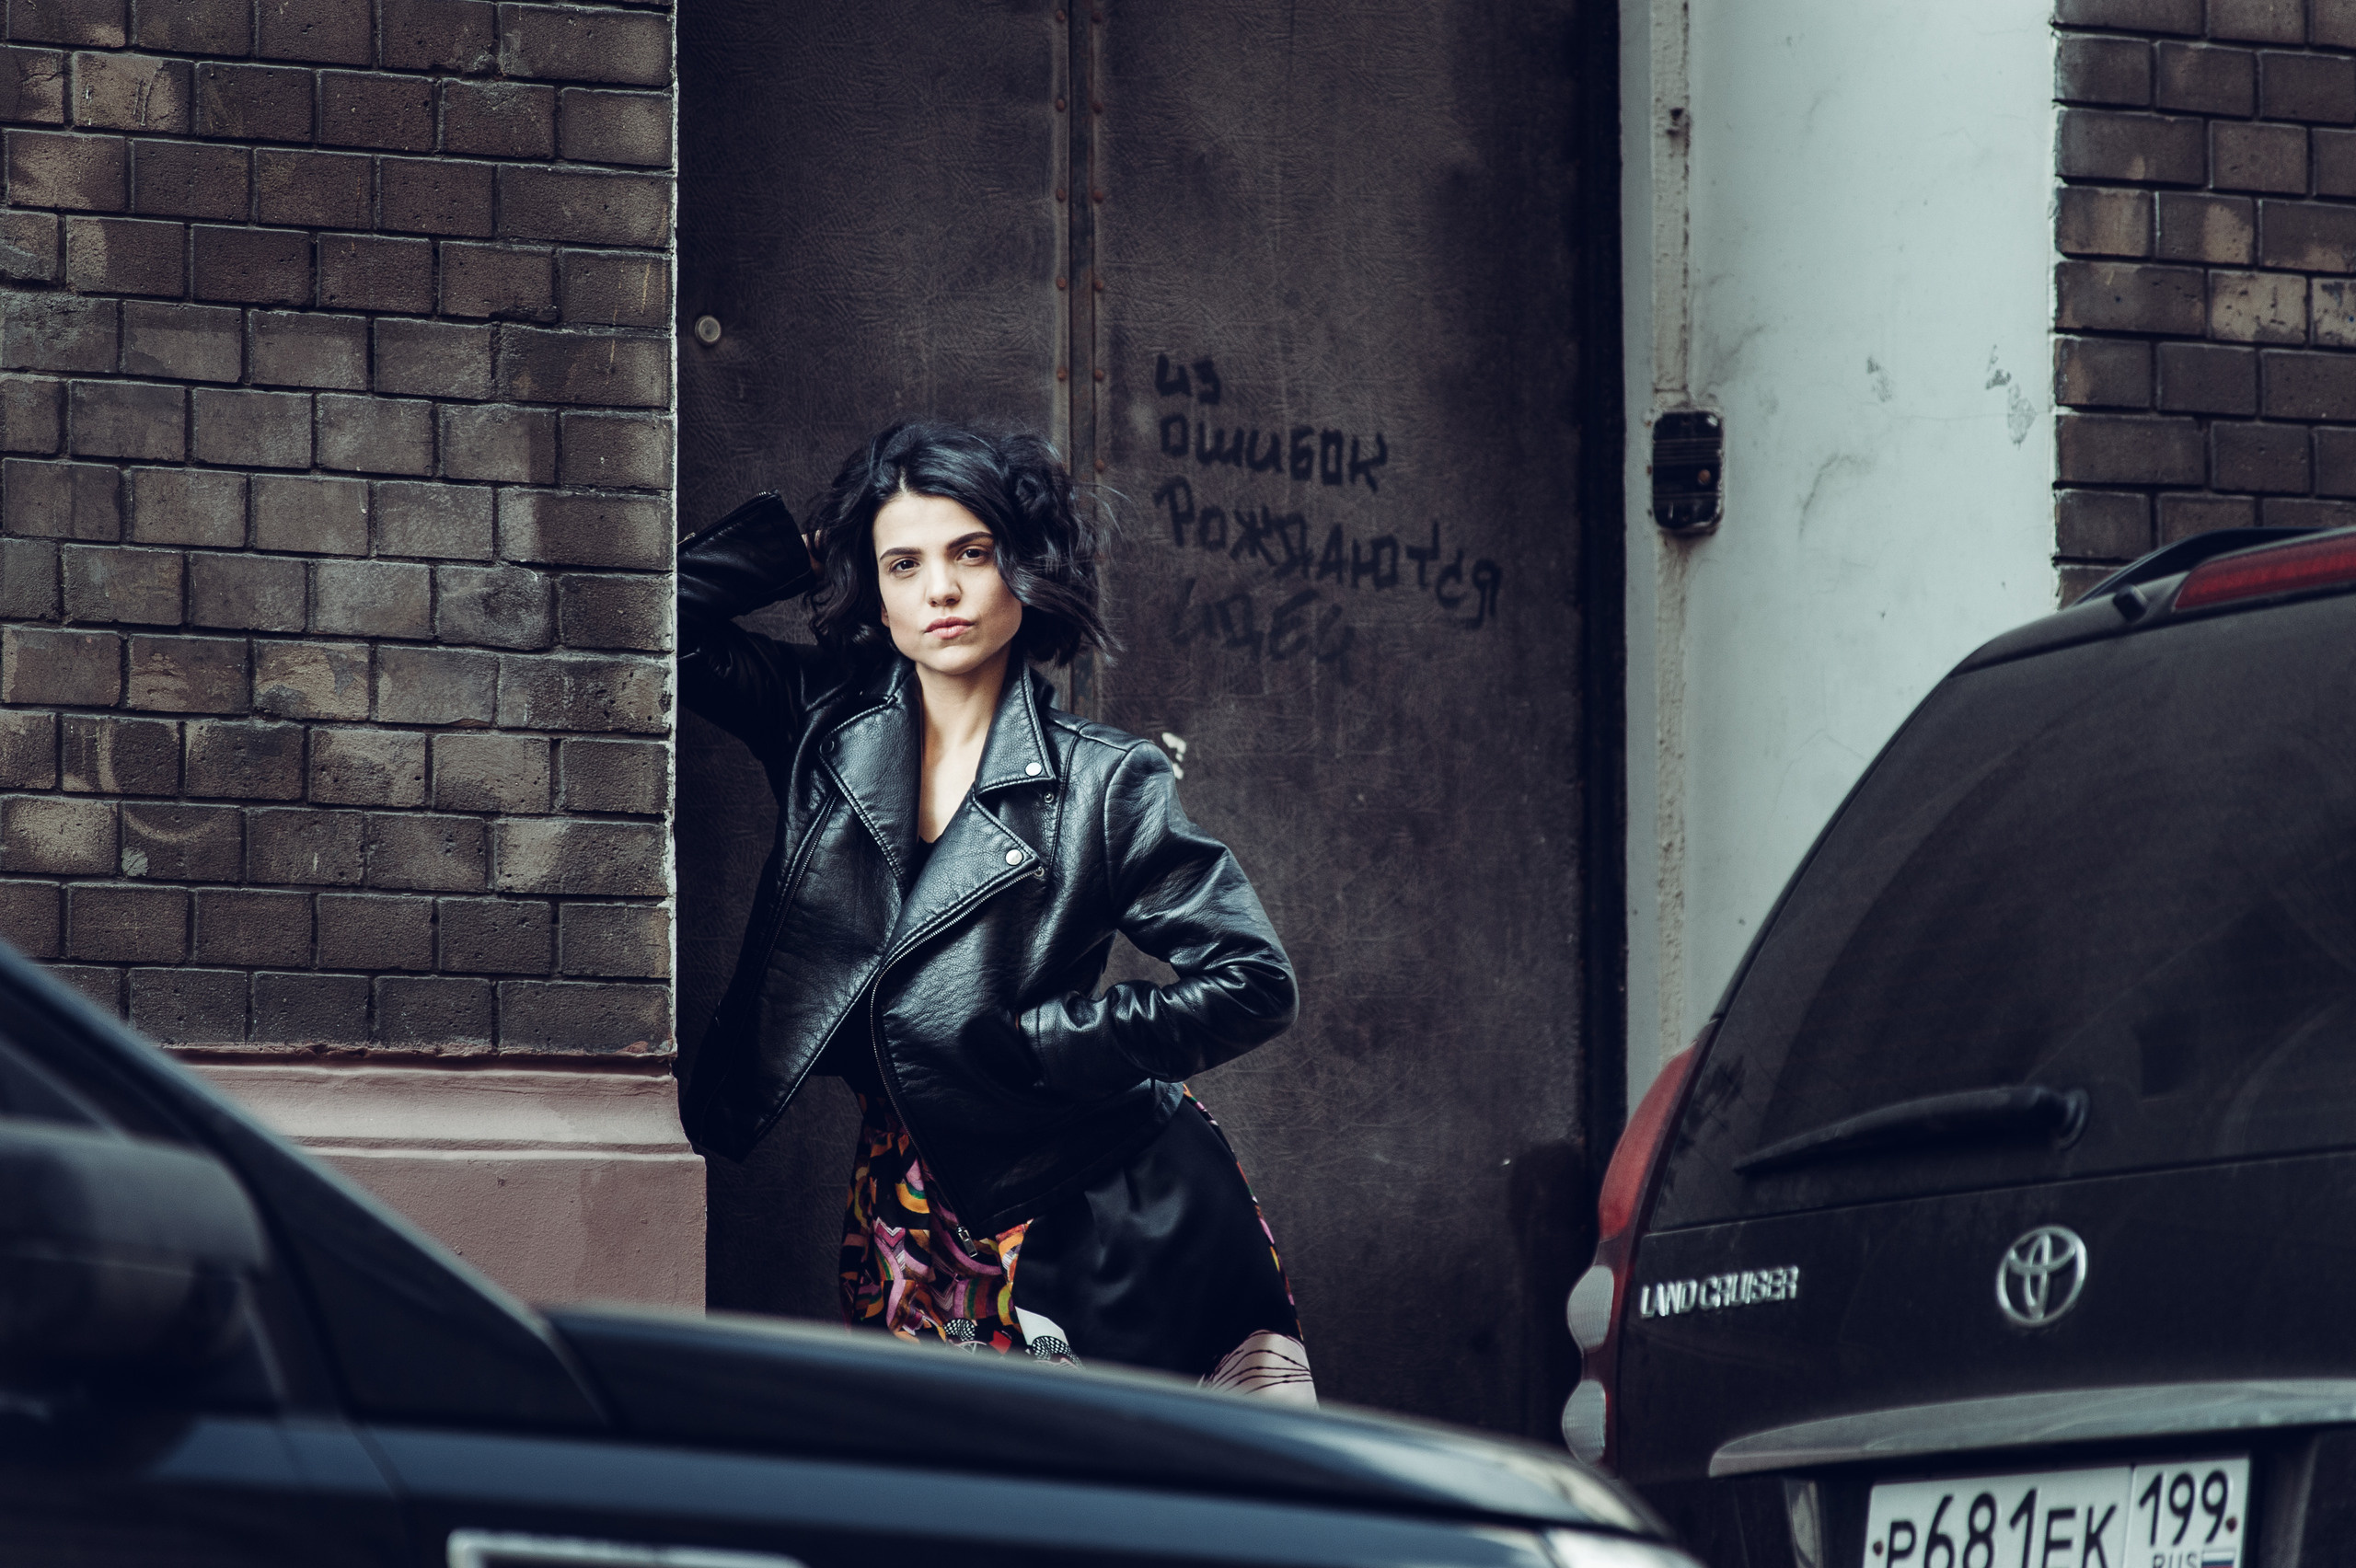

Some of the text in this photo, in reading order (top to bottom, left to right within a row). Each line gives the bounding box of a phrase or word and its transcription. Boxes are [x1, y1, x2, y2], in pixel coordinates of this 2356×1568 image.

[1640, 1265, 1799, 1319] LAND CRUISER
[2139, 1470, 2229, 1547] 199
